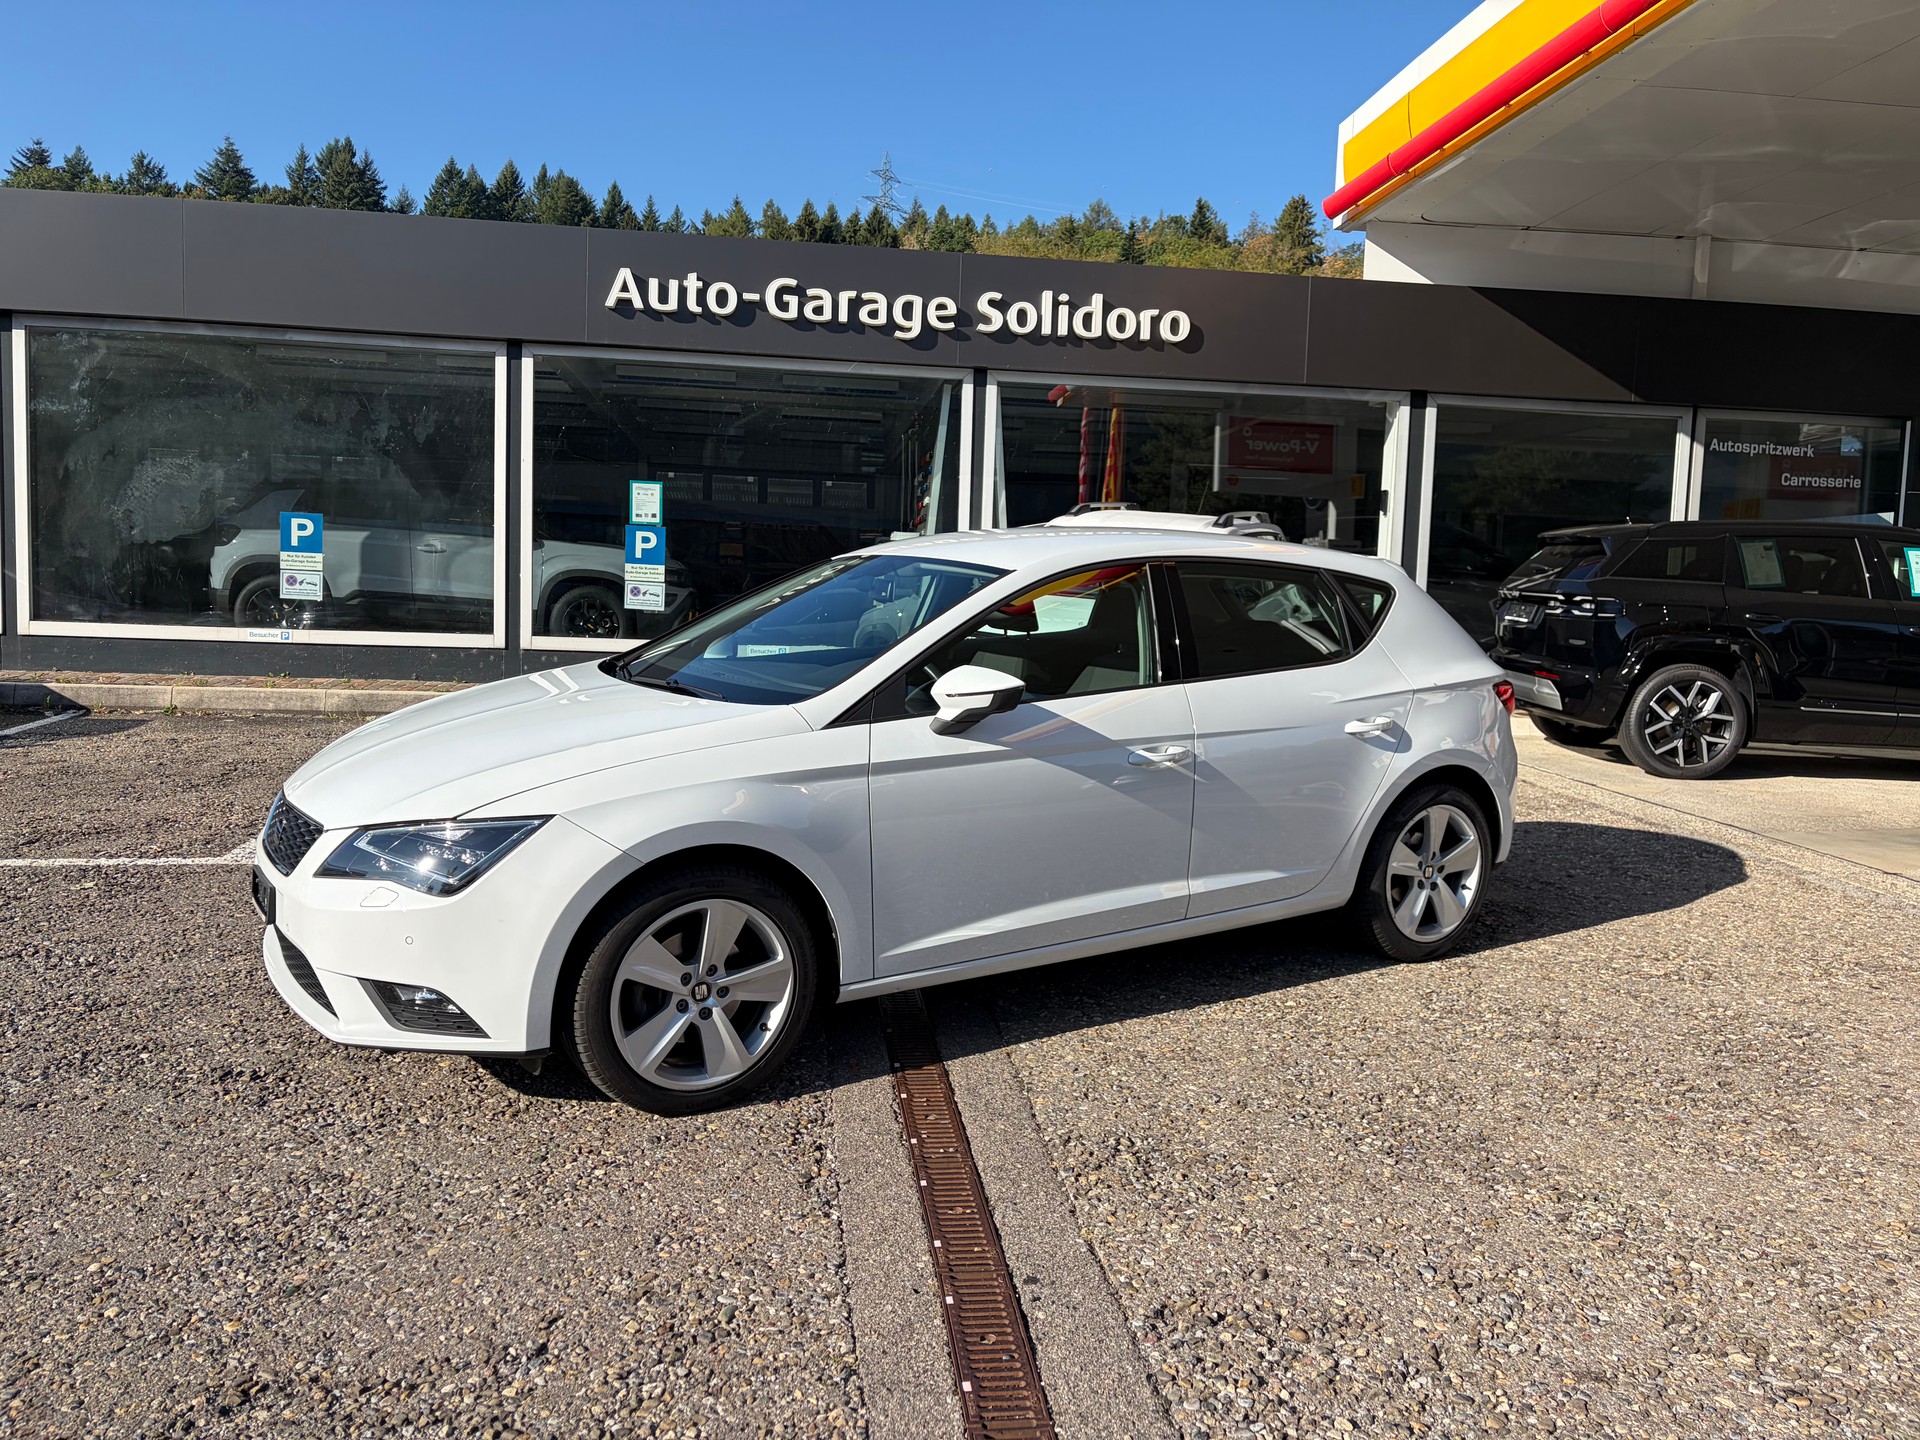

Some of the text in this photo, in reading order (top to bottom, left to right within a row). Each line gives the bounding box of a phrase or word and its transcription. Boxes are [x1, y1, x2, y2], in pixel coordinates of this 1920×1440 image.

[605, 266, 1192, 344] Auto-Garage Solidoro
[1709, 438, 1815, 458] Autospritzwerk
[1781, 472, 1862, 489] Carrosserie
[291, 517, 315, 547] P
[635, 530, 658, 559] P
